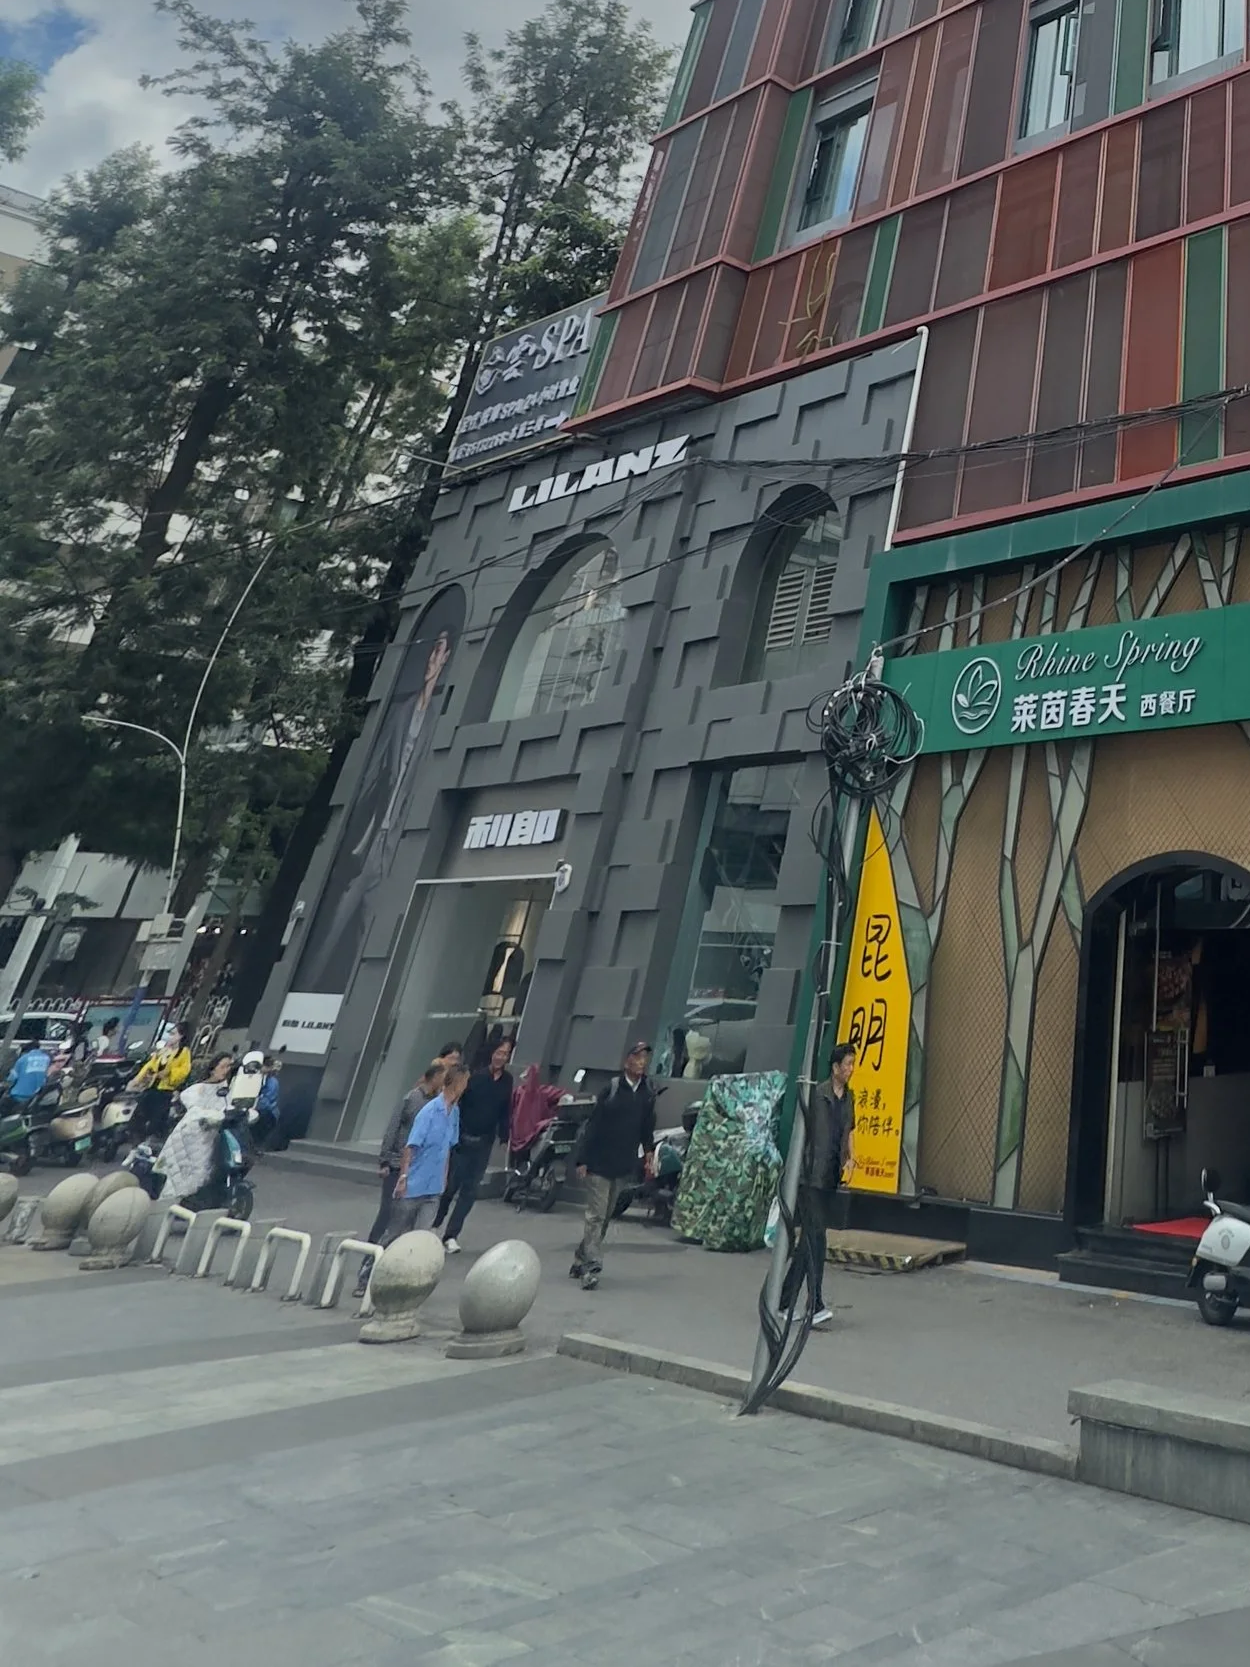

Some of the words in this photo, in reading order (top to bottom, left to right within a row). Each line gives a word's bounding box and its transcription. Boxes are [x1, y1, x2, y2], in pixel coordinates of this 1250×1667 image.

[507, 434, 690, 513] LILANZ
[1015, 642, 1097, 682] Rhine
[1104, 629, 1203, 682] Spring
[1010, 683, 1127, 733] 莱茵春天
[1140, 688, 1196, 717] 西餐厅
[463, 809, 561, 850] 利郎
[848, 914, 893, 1072] 昆明
